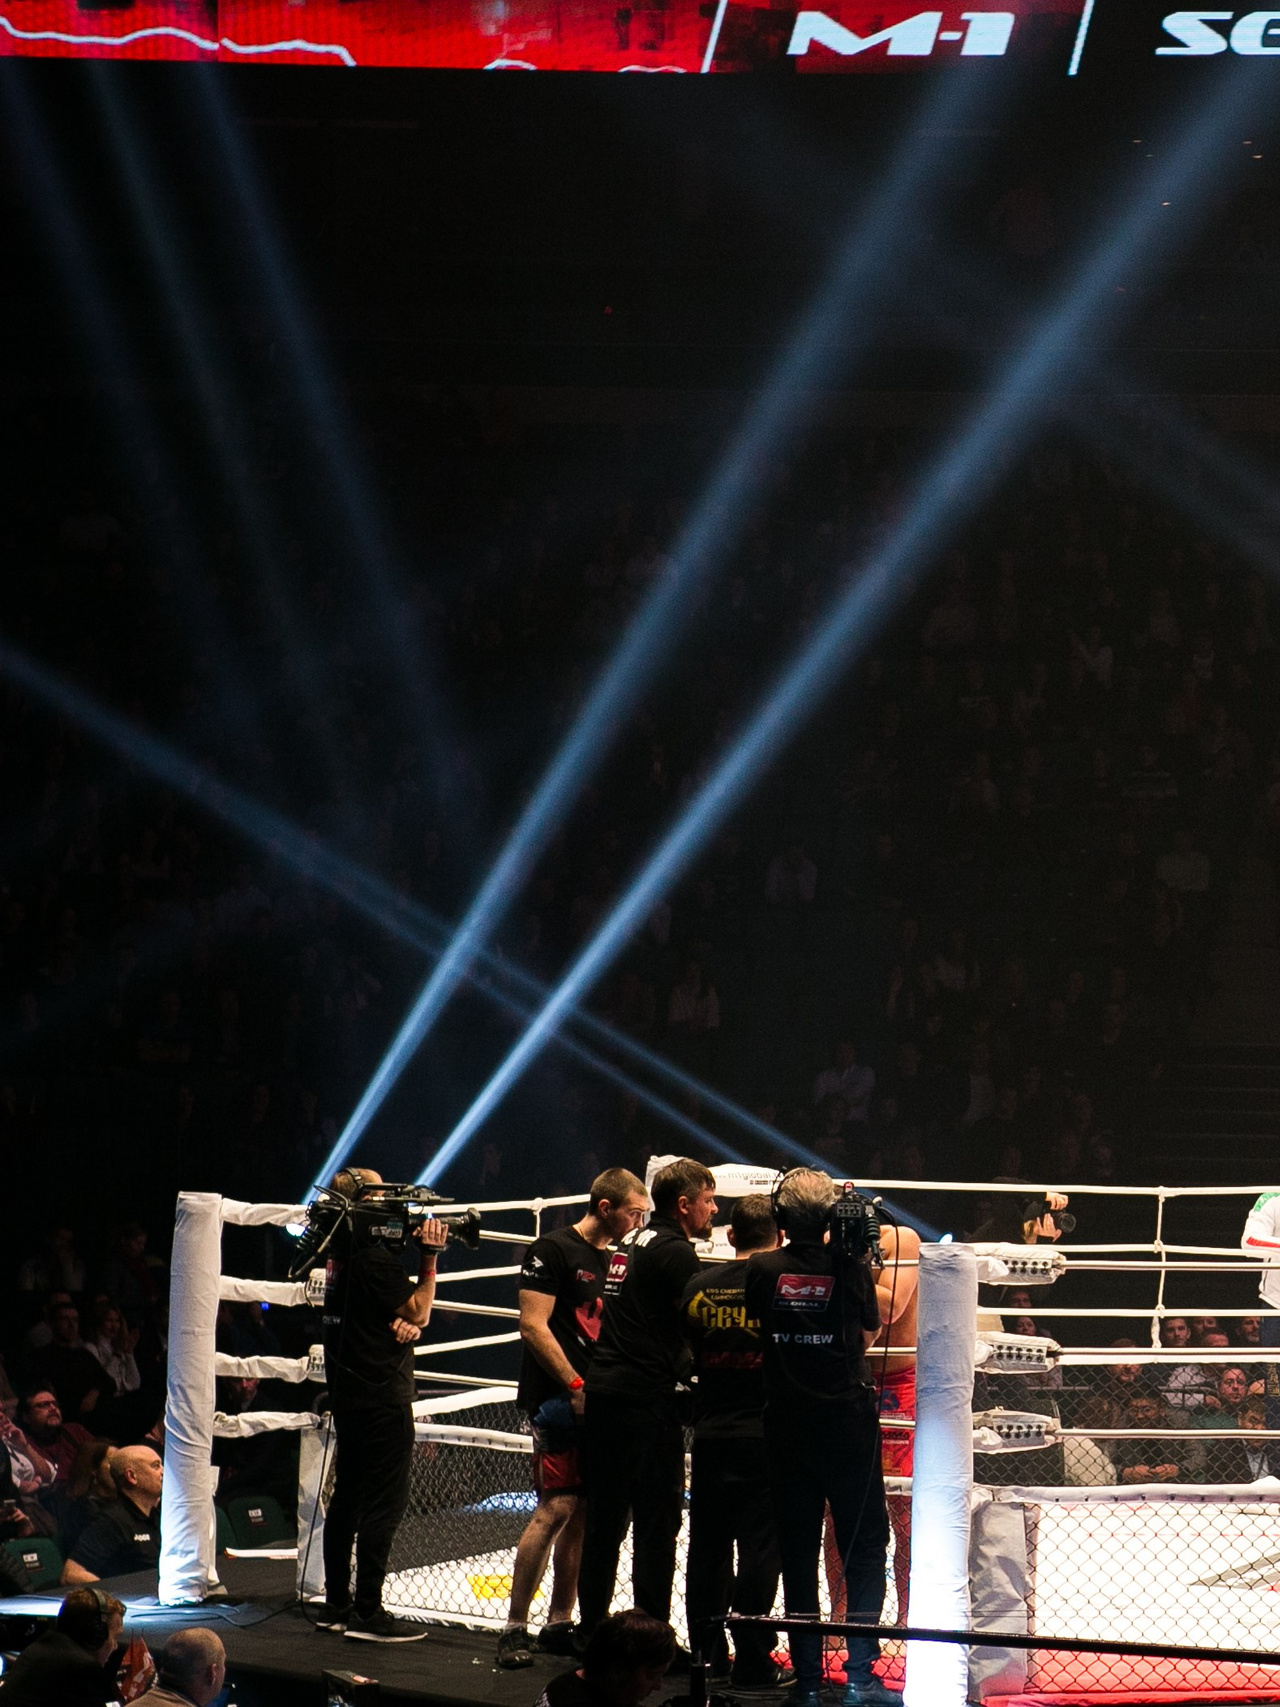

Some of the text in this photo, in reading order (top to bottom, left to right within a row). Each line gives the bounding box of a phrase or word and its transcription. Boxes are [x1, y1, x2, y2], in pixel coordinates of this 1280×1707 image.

[787, 11, 1015, 56] M-1
[781, 1284, 826, 1296] M-1
[772, 1333, 834, 1345] TV CREW
